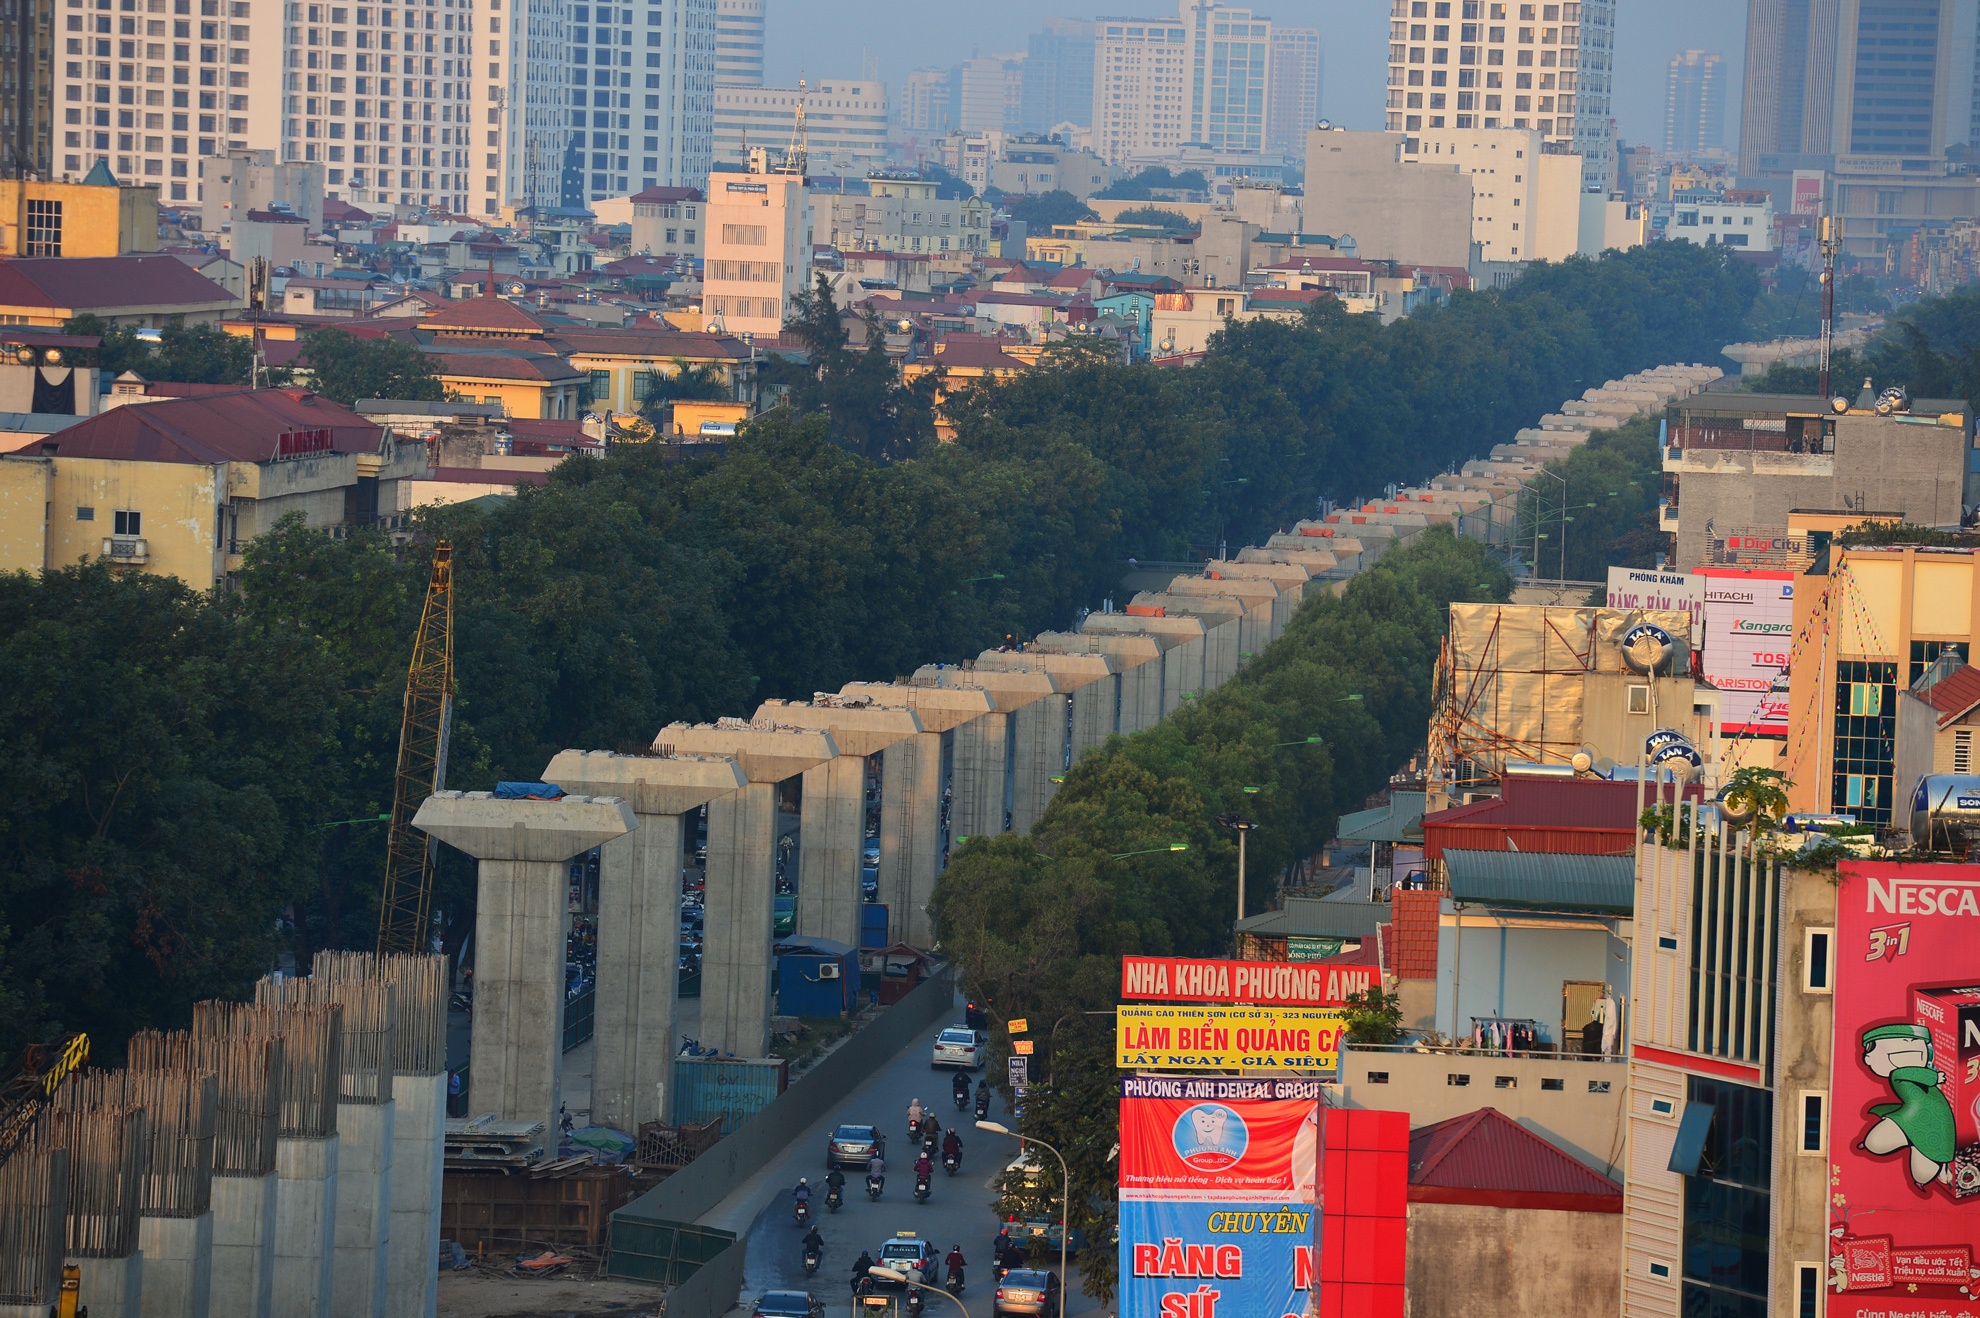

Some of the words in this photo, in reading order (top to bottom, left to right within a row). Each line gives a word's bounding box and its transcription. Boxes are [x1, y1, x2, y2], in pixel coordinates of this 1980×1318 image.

[1744, 537, 1800, 553] DigiCity
[1629, 570, 1658, 583] PHÒNG
[1660, 574, 1685, 586] KHÁM
[1704, 591, 1754, 600] HITACHI
[1715, 678, 1772, 690] ARISTON
[1126, 962, 1169, 995] NHA
[1175, 964, 1230, 997] KHOA
[1235, 964, 1321, 1000] PHƯƠNG
[1326, 969, 1370, 1002] ANH
[1121, 1007, 1153, 1017] QUẢNG
[1156, 1008, 1175, 1018] CÁO
[1177, 1009, 1204, 1018] THIÊN
[1207, 1010, 1226, 1018] SƠN
[1282, 1011, 1299, 1020] 323
[1916, 997, 1945, 1024] NESCAFÉ
[1124, 1021, 1170, 1050] LÀM
[1178, 1018, 1229, 1051] BIỂN
[1236, 1018, 1310, 1054] QUẢNG
[1122, 1052, 1162, 1065] LẤY
[1167, 1056, 1226, 1065] NGAY
[1241, 1054, 1279, 1066] GIÁ
[1283, 1055, 1330, 1067] SIÊU
[1125, 1079, 1181, 1098] PHƯƠNG
[1185, 1081, 1214, 1098] ANH
[1218, 1082, 1272, 1098] DENTAL
[1220, 1146, 1238, 1157] ANH
[1125, 1174, 1154, 1184] Thương
[1156, 1175, 1172, 1185] hiệu
[1188, 1175, 1208, 1185] tiếng
[1215, 1176, 1232, 1185] Dịch
[1234, 1177, 1244, 1185] vụ
[1208, 1205, 1310, 1234] CHUYÊN
[1133, 1237, 1242, 1278] RĂNG
[1896, 1256, 1911, 1265] Vạn
[1893, 1265, 1914, 1276] Triệu
